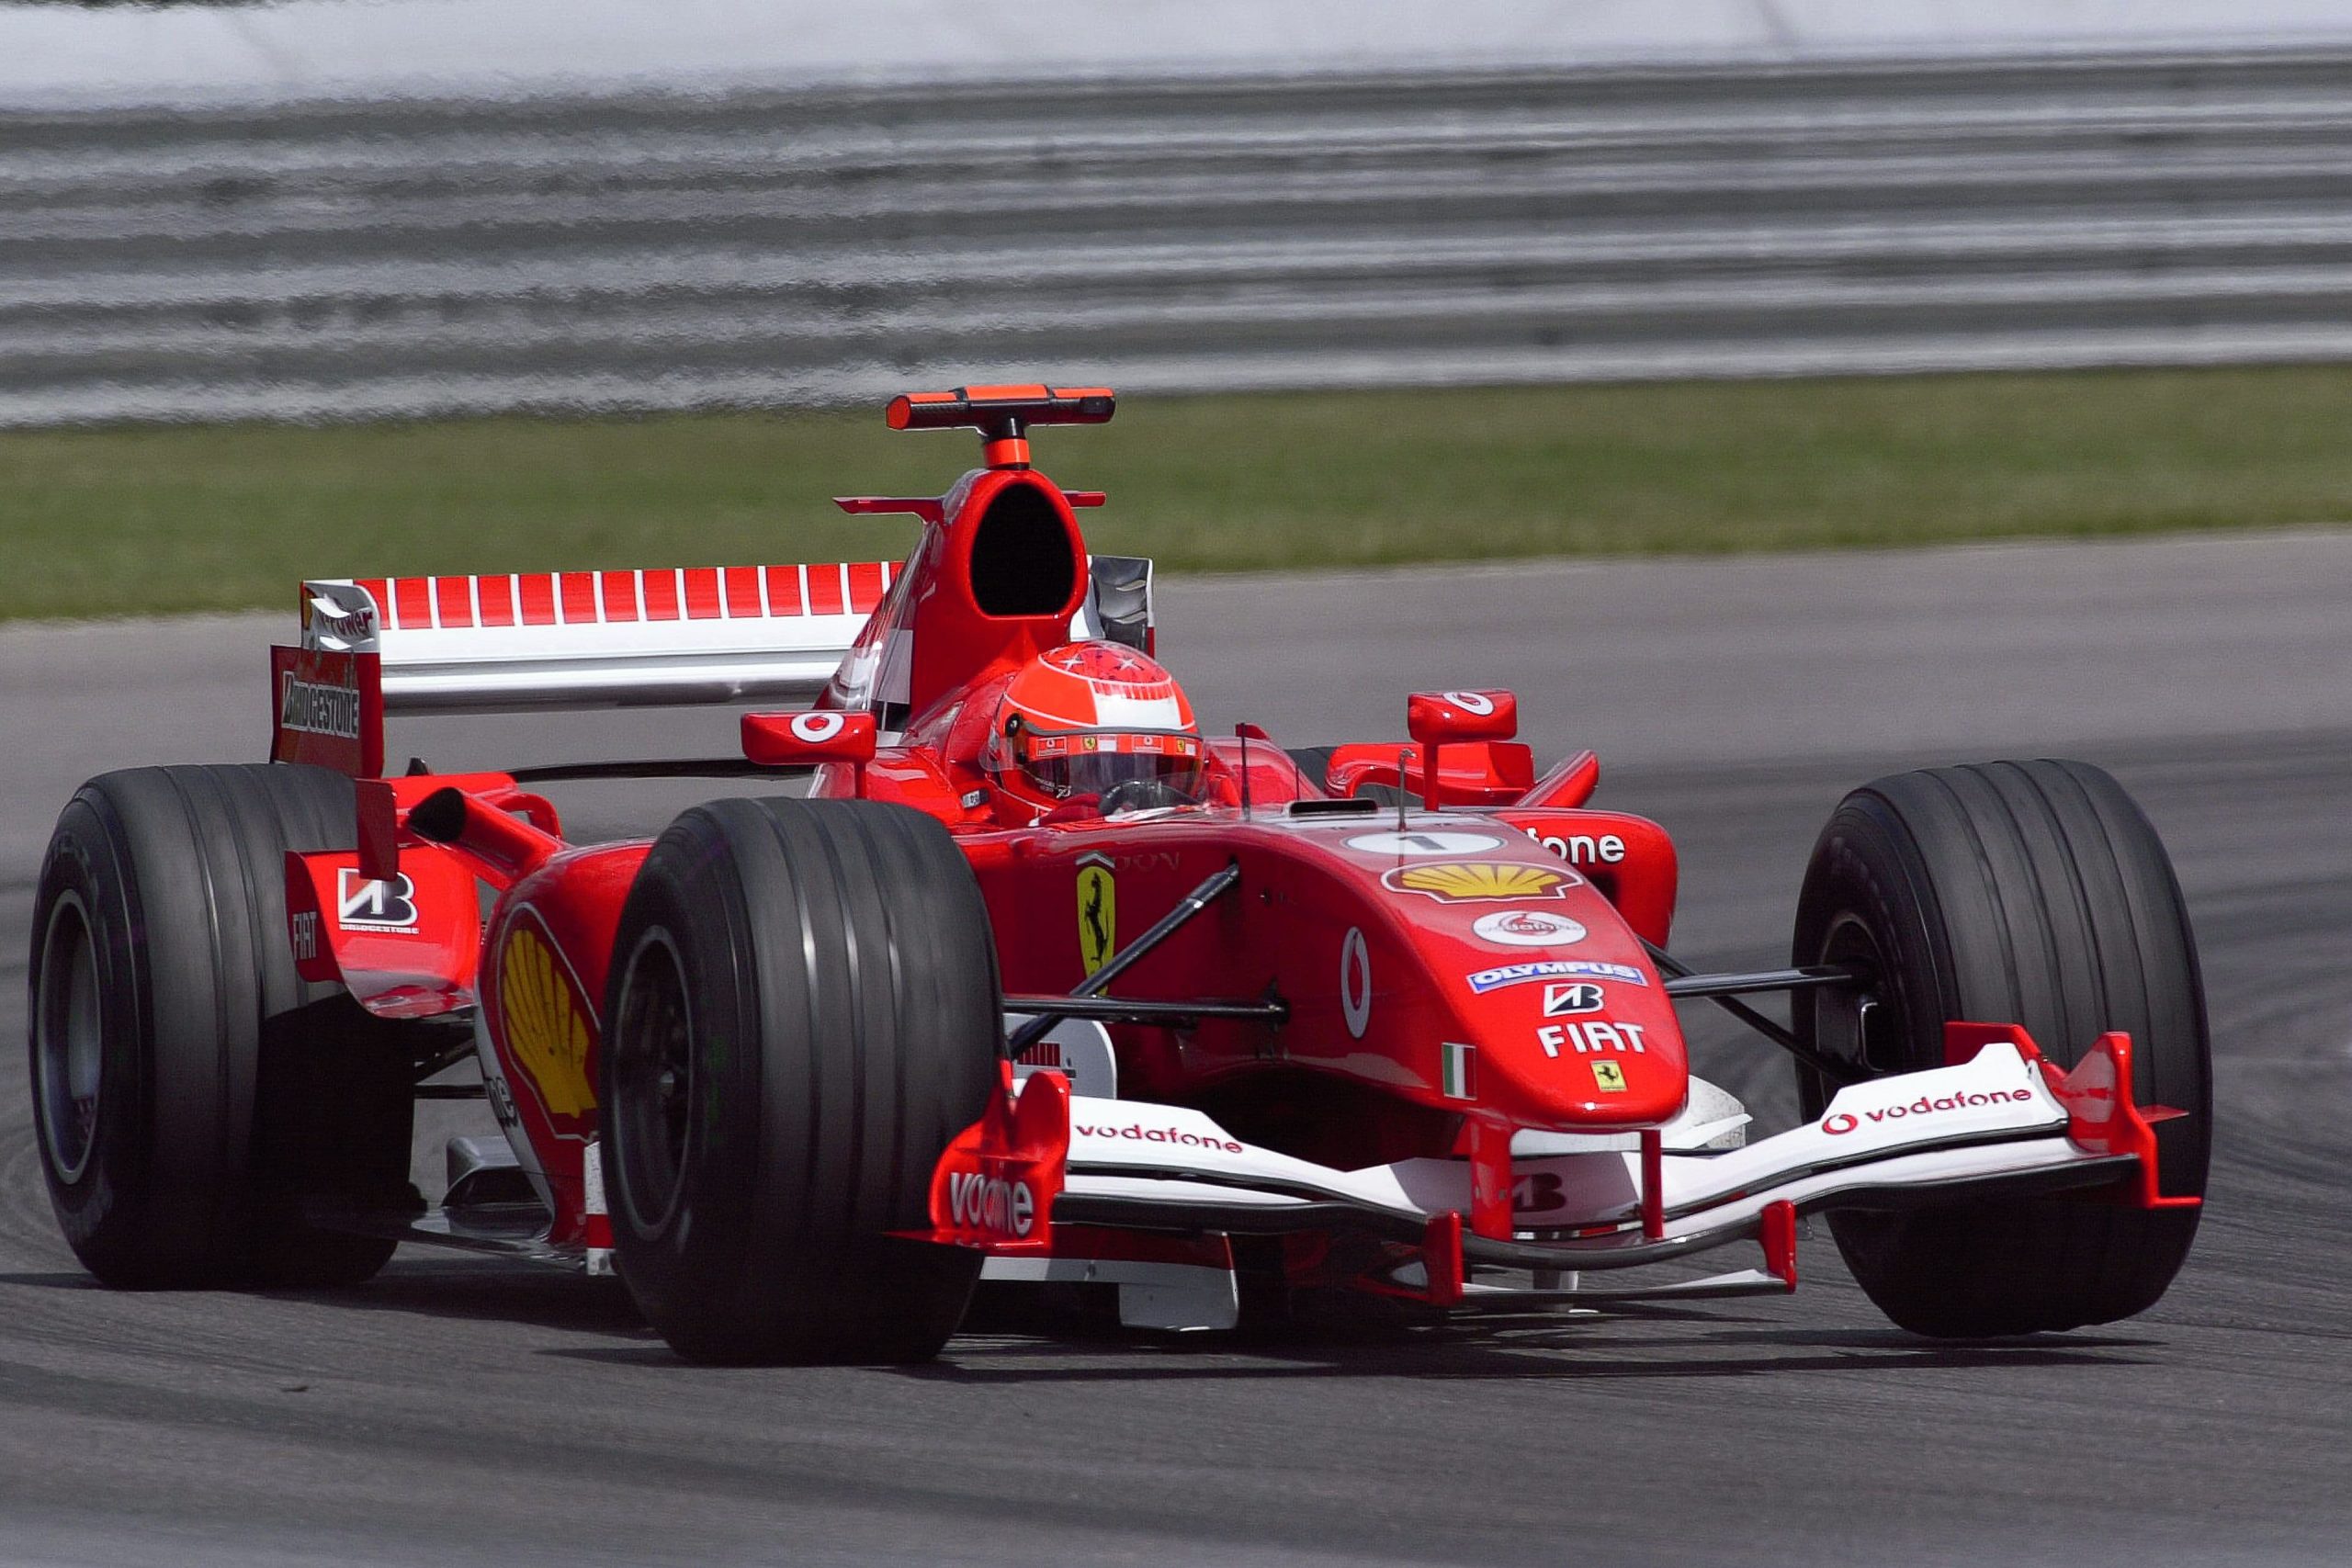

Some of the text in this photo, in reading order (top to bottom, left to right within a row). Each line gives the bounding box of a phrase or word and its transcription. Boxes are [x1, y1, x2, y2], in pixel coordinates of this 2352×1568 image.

[292, 911, 317, 961] FIAT
[1474, 963, 1638, 986] OLYMPUS
[1536, 1021, 1645, 1058] FIAT
[1865, 1089, 2031, 1122] vodafone
[1075, 1124, 1244, 1154] vodafone
